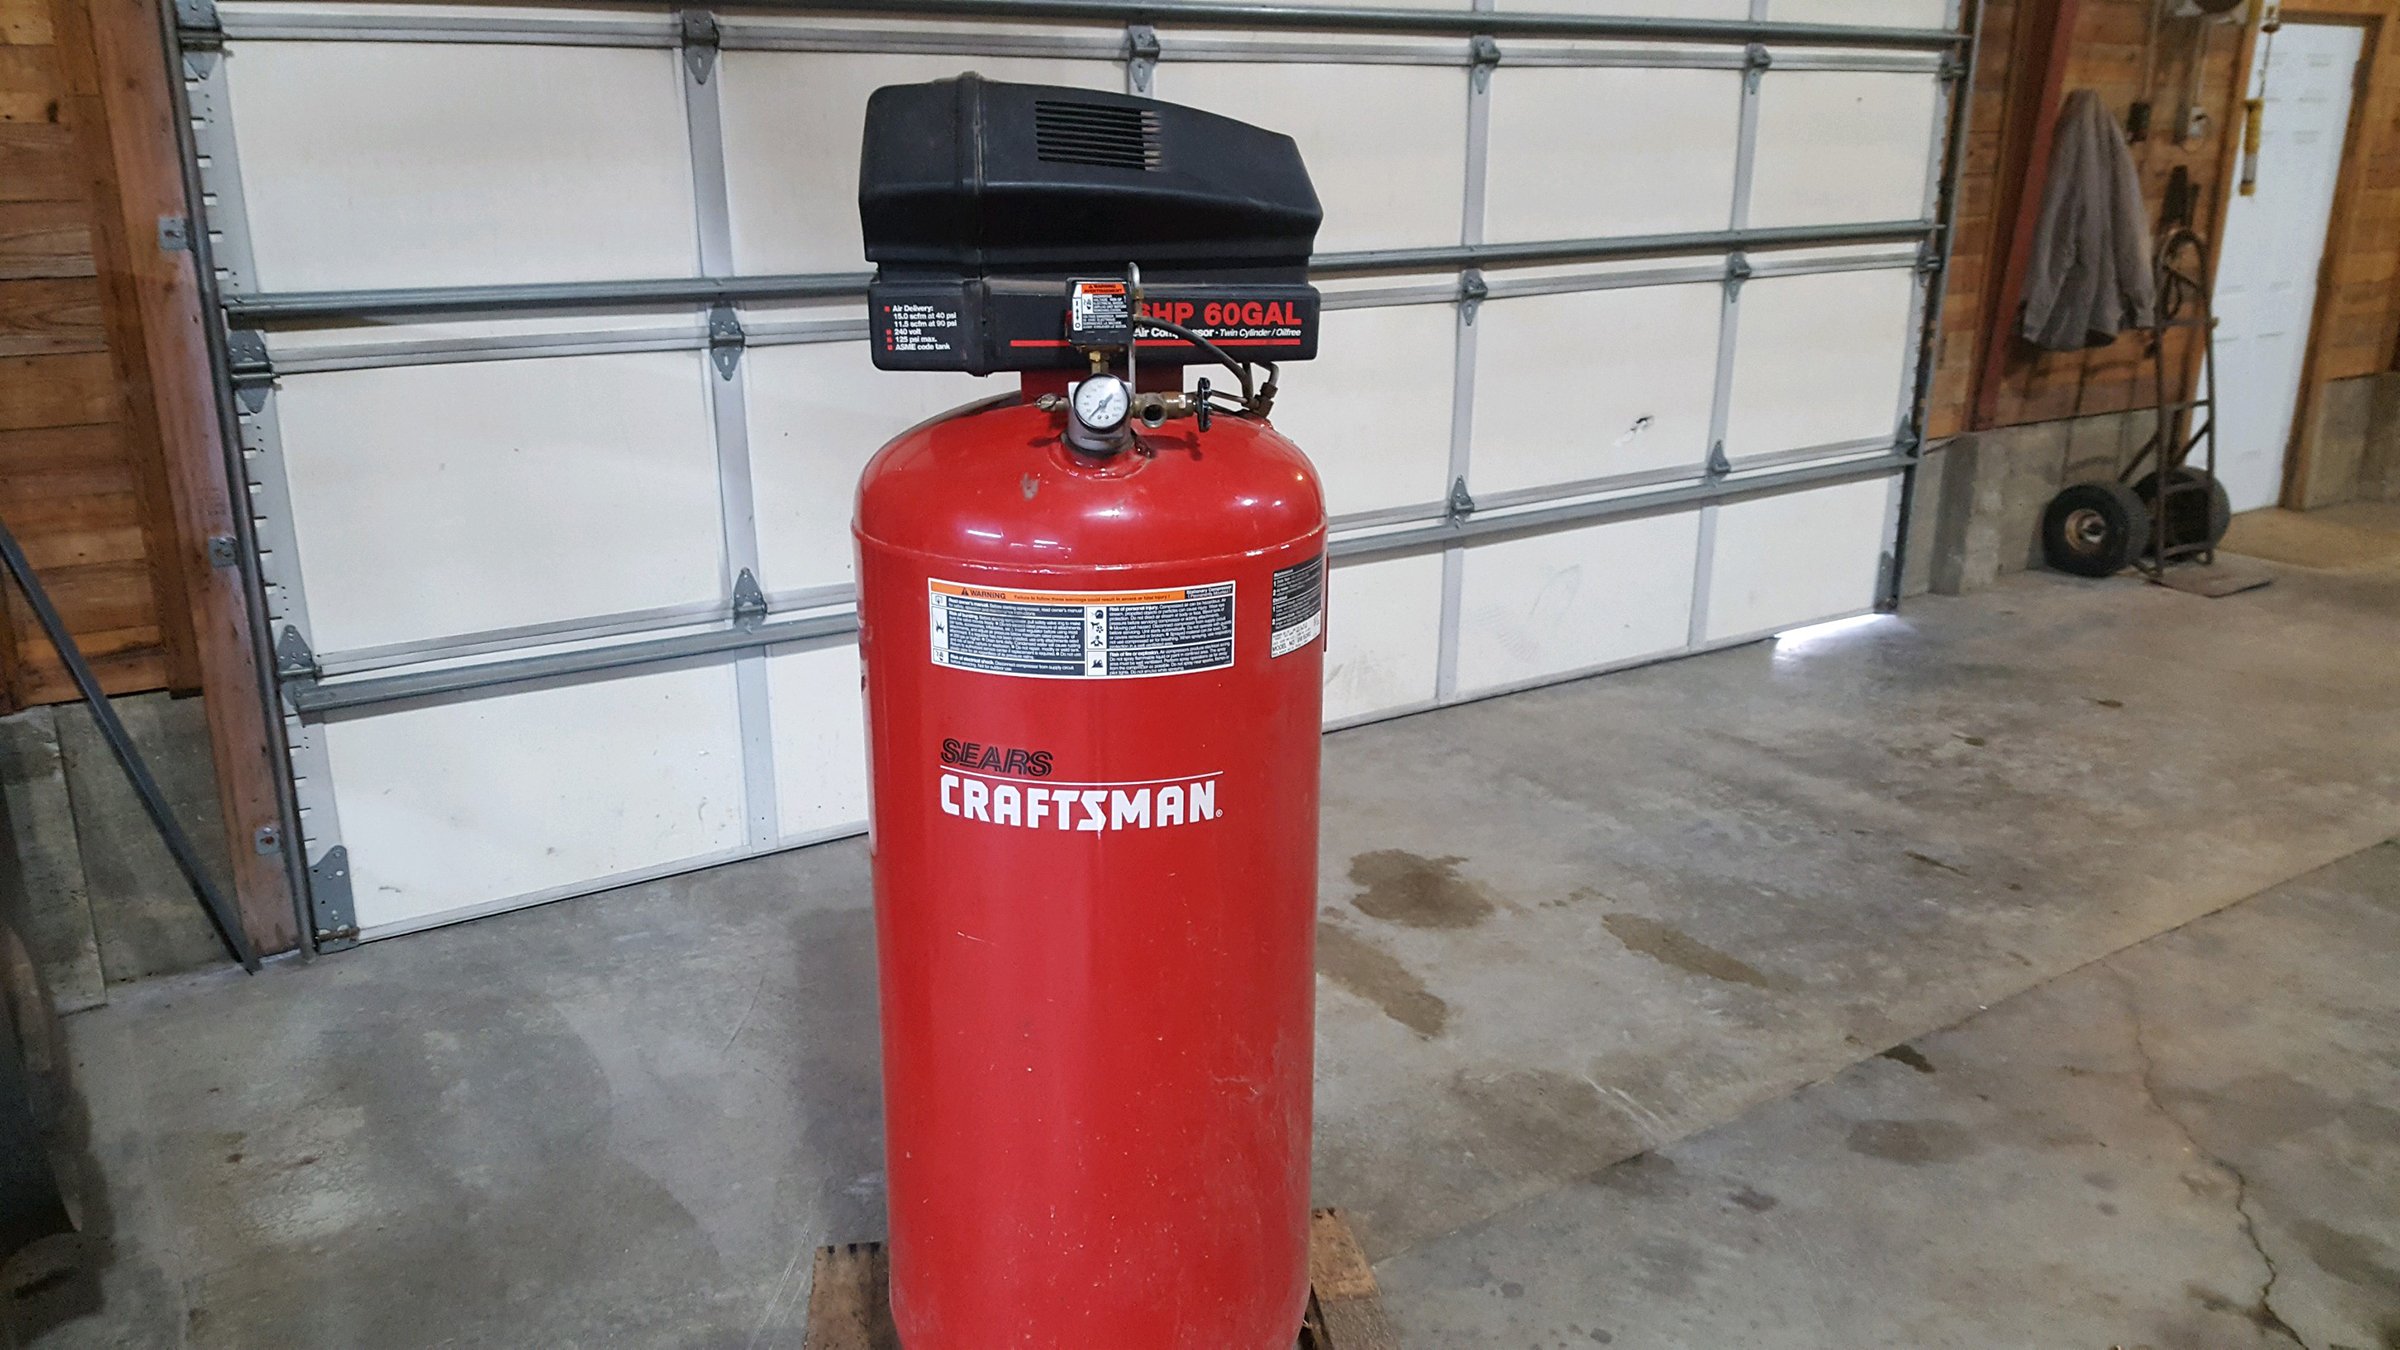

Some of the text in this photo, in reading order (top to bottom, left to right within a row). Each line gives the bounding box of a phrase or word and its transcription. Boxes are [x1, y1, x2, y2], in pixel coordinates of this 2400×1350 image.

[1204, 302, 1302, 326] 60GAL
[1220, 328, 1238, 337] Twin
[1239, 328, 1271, 338] Cylinder
[1276, 328, 1302, 337] Oilfree
[970, 590, 1006, 599] WARNING
[940, 738, 1053, 776] SEARS
[940, 774, 1215, 831] CRAFTSMAN
